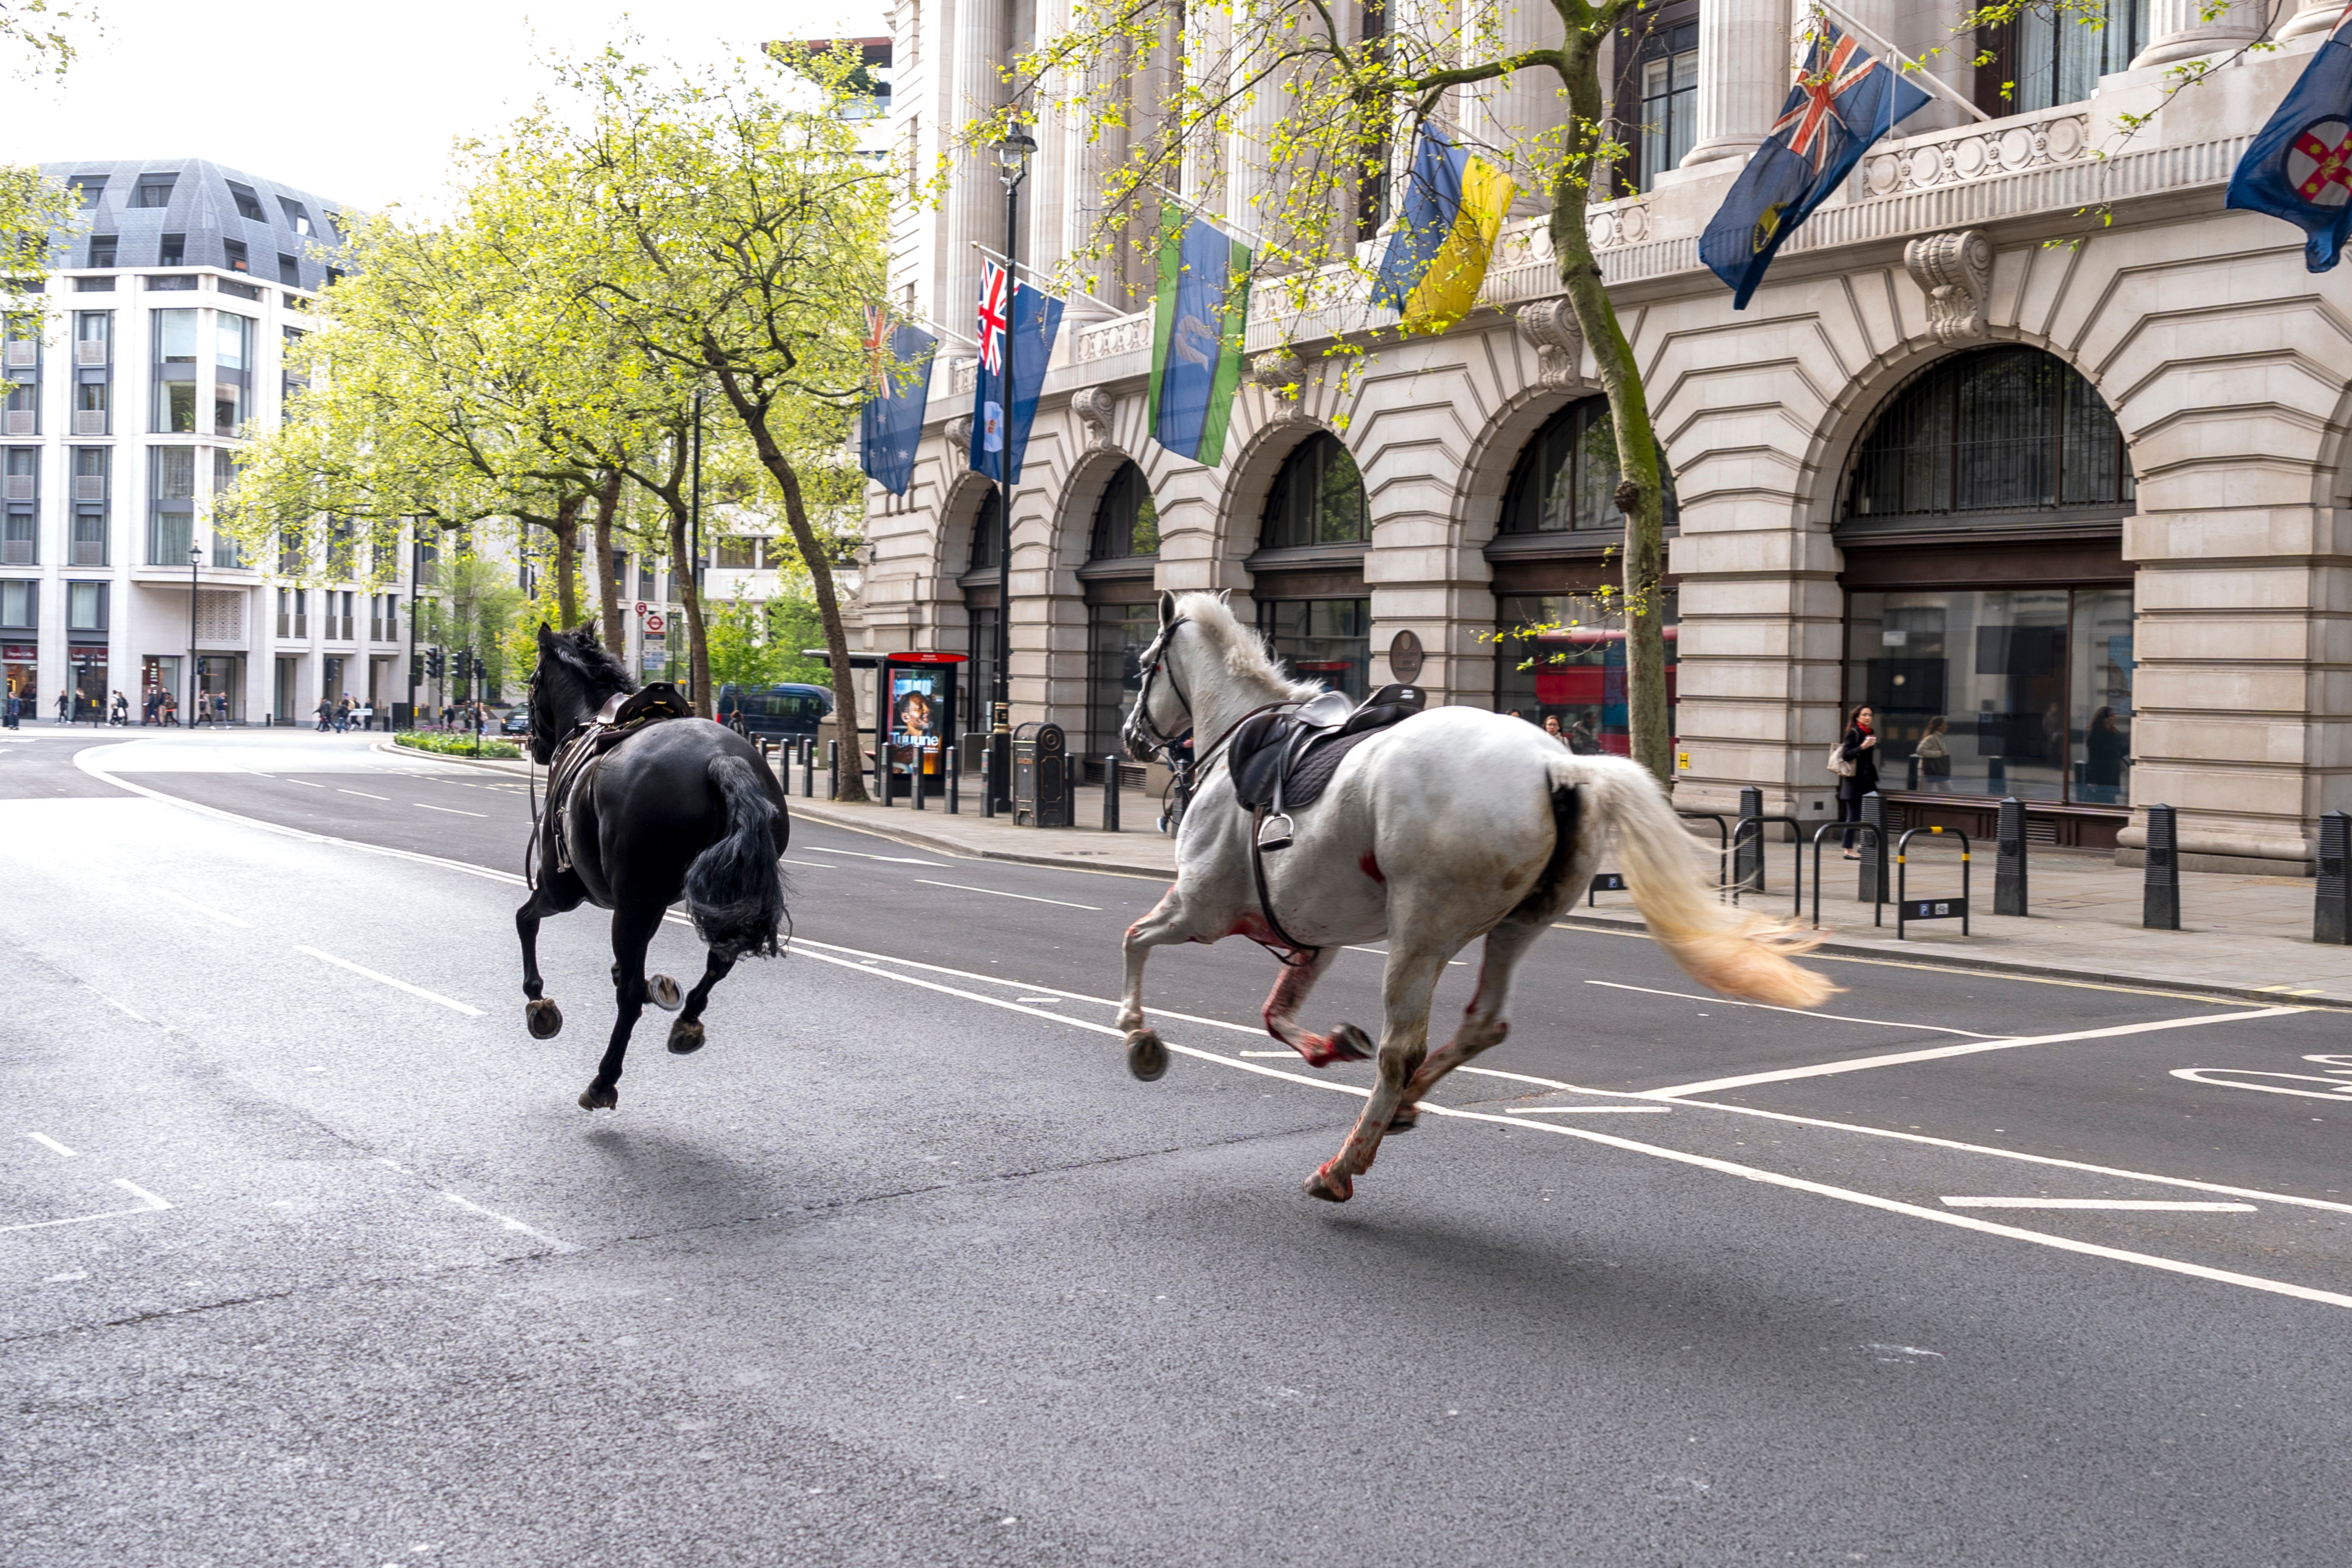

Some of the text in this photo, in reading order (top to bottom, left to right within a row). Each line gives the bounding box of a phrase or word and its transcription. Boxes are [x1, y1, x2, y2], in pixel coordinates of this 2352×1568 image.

[636, 603, 646, 612] G
[1610, 878, 1616, 886] P
[1921, 906, 1928, 915] P
